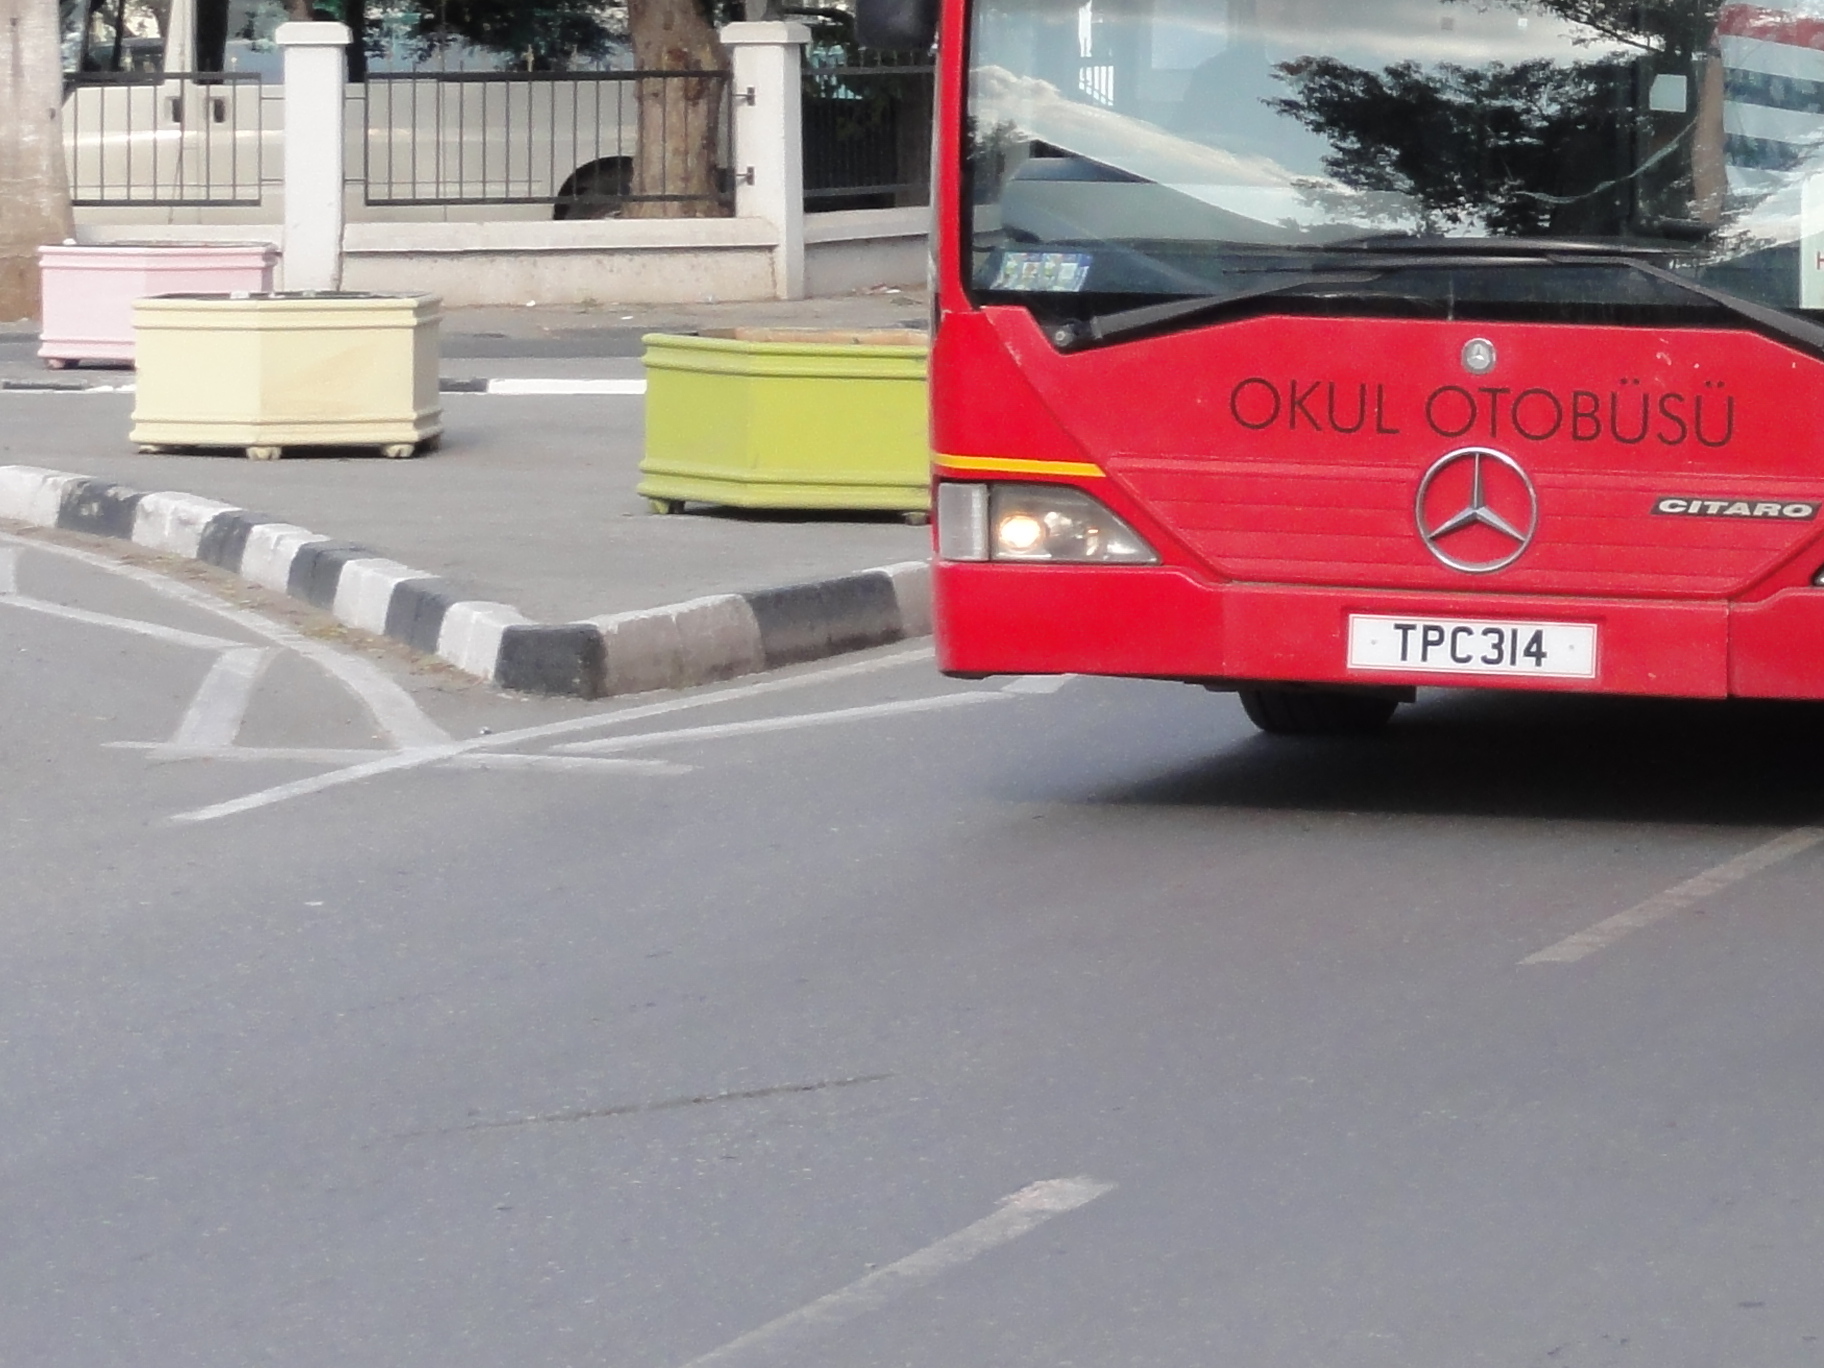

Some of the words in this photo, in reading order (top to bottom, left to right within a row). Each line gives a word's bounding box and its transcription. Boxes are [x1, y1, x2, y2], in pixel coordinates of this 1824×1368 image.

[1229, 376, 1400, 435] OKUL
[1424, 378, 1735, 448] OTOBÜSÜ
[1658, 499, 1813, 518] CITARO
